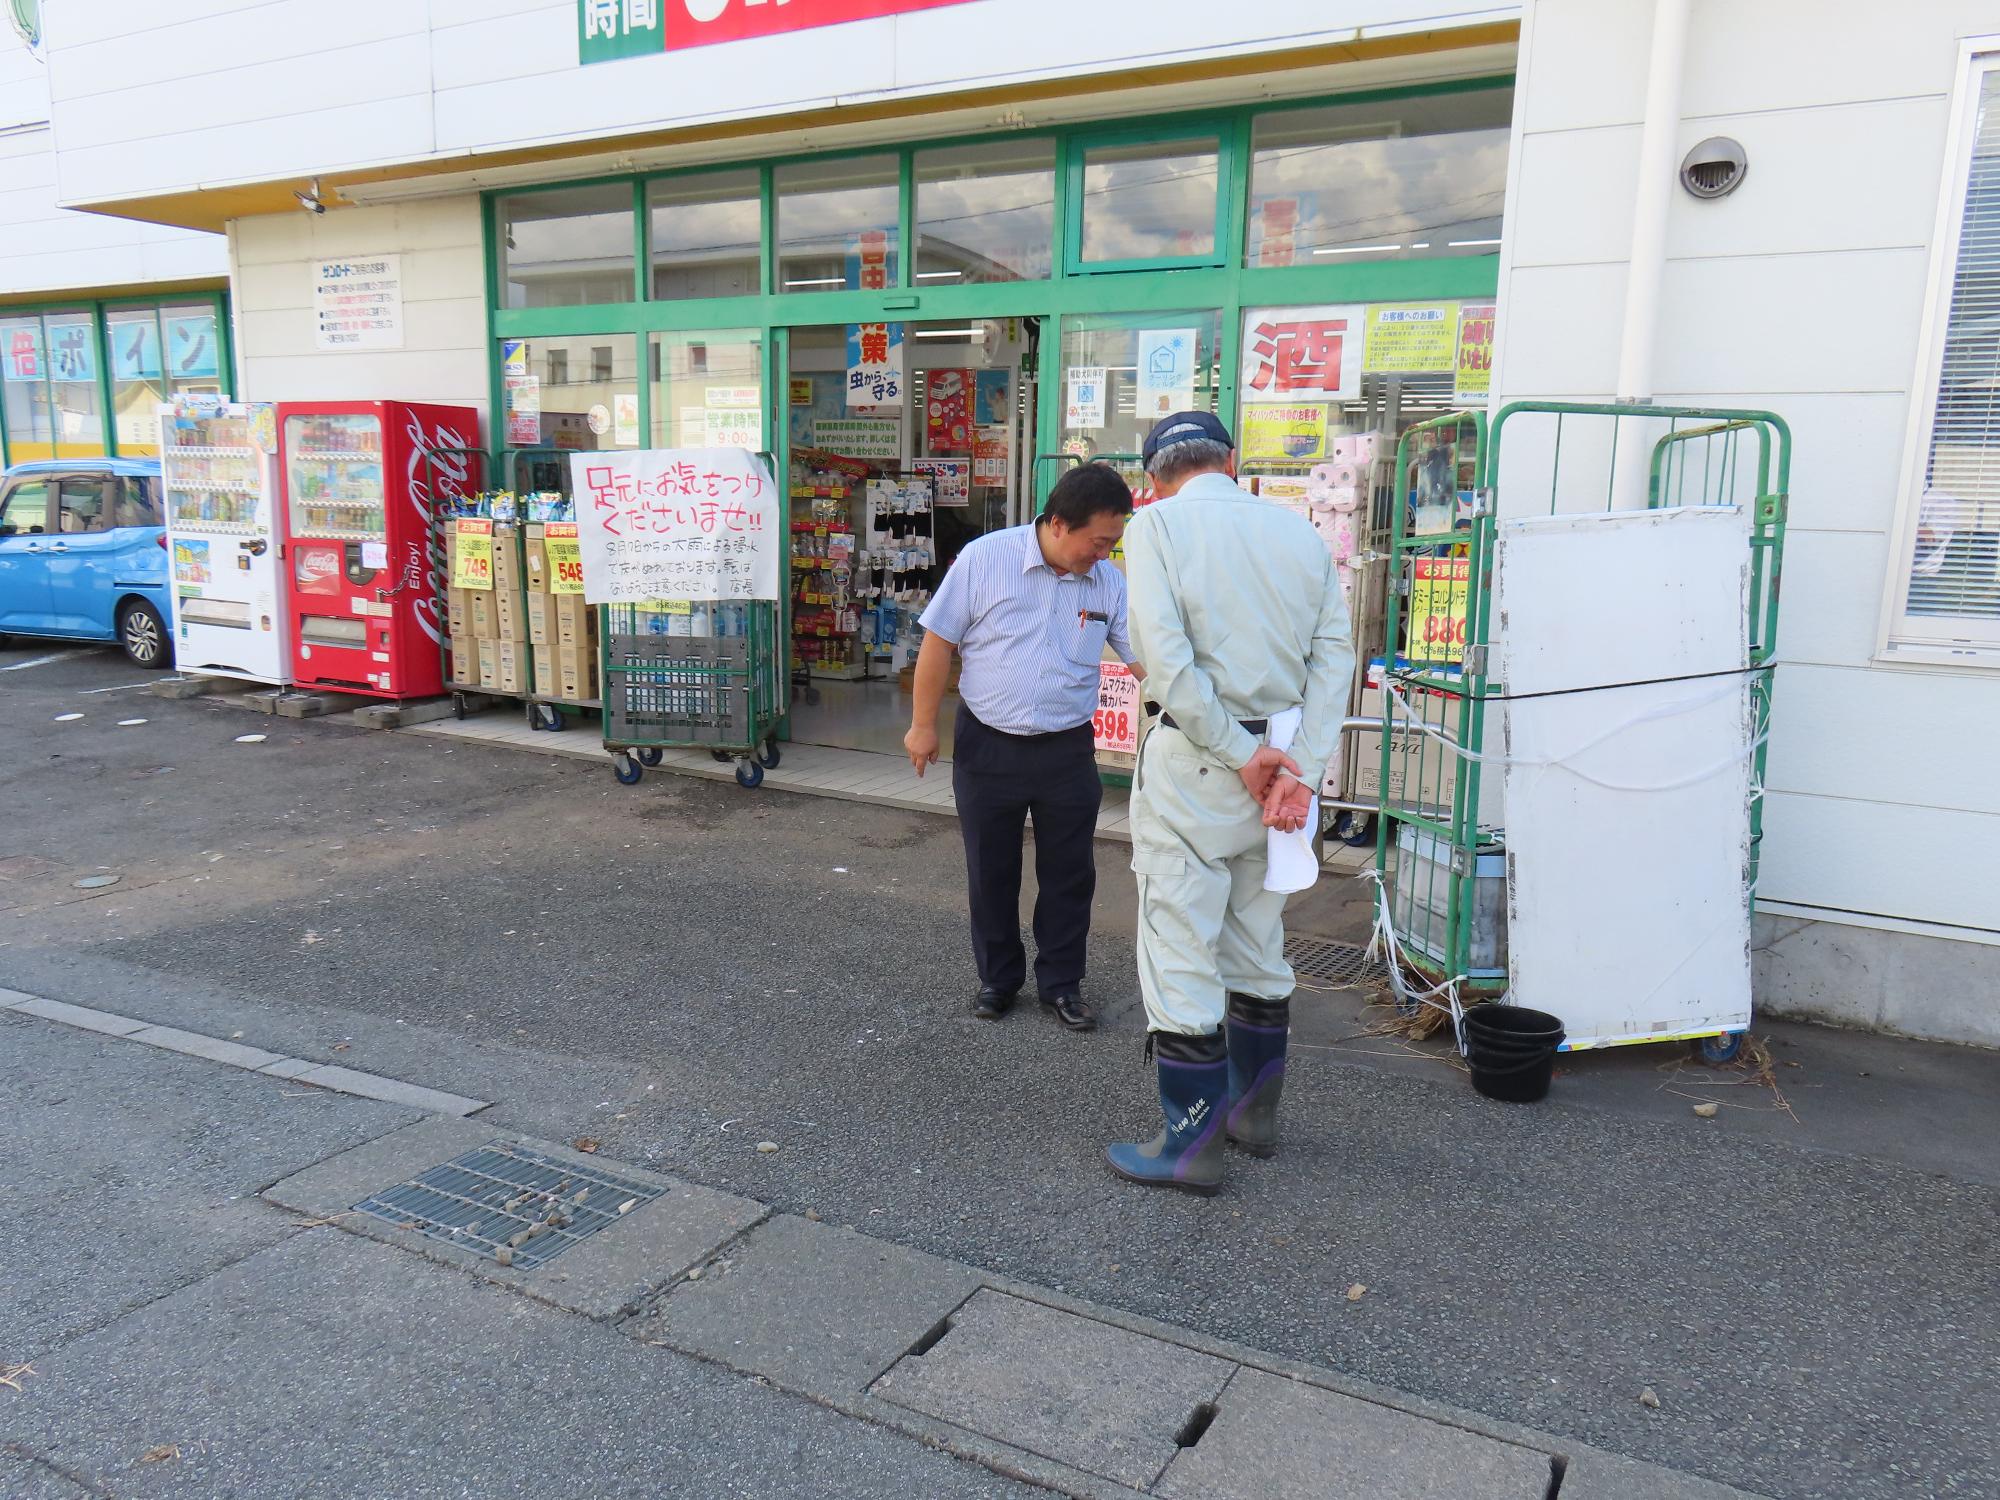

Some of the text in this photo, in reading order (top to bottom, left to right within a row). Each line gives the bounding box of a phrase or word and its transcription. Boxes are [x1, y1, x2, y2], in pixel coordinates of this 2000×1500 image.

[1381, 310, 1443, 322] お客様へのお願い
[1249, 319, 1348, 393] 酒
[586, 461, 764, 510] 足元にお気をつけ
[462, 522, 487, 532] お買得
[550, 526, 577, 537] お買得
[408, 542, 421, 590] Enjoy!
[463, 558, 488, 578] 748
[558, 562, 584, 582] 548
[1423, 615, 1468, 645] 880
[1099, 676, 1137, 695] ムマグネット
[1187, 1097, 1206, 1122] Max
